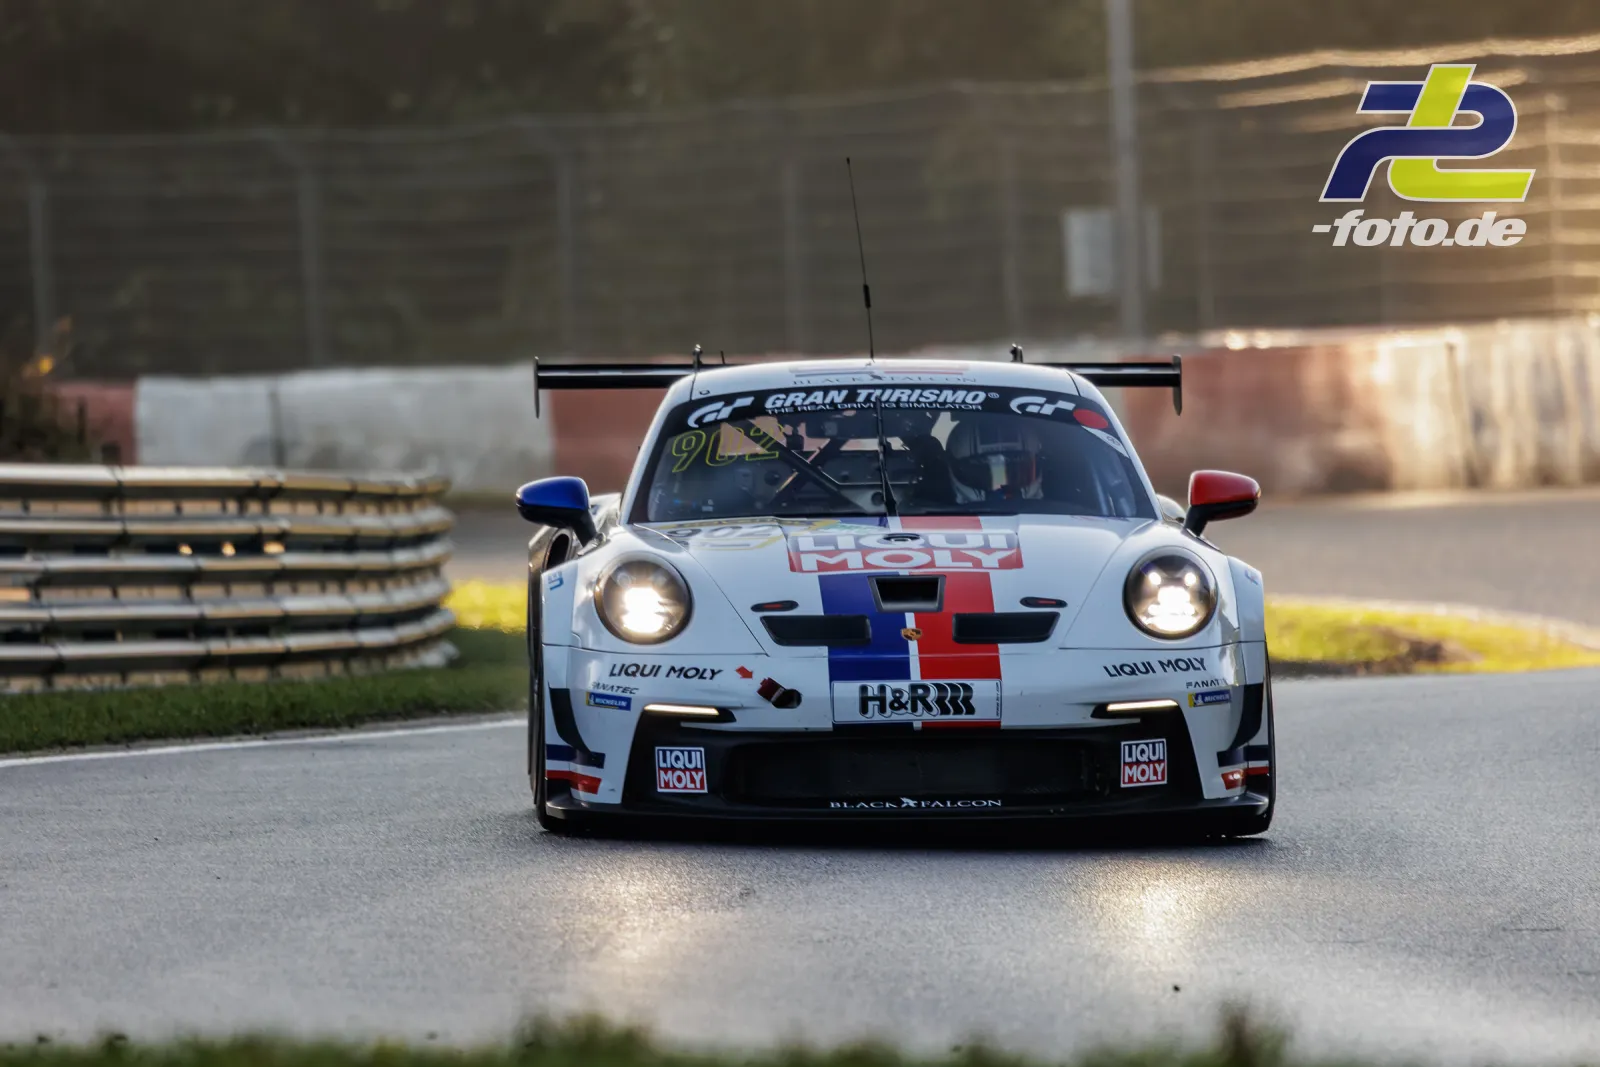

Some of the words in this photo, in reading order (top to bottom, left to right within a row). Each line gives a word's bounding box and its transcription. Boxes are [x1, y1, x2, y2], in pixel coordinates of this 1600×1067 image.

[764, 390, 849, 409] GRAN
[766, 407, 795, 415] THE
[799, 403, 836, 413] REAL
[900, 402, 982, 411] SIMULATOR
[672, 424, 784, 473] 902
[798, 533, 1009, 550] LIQUI
[800, 549, 1015, 571] MOLY
[608, 663, 662, 678] LIQUI
[665, 665, 723, 680] MOLY
[1103, 661, 1156, 677] LIQUI
[1158, 657, 1207, 673] MOLY
[659, 751, 701, 769] LIQUI
[1125, 743, 1164, 762] LIQUI
[660, 770, 703, 789] MOLY
[1125, 763, 1165, 783] MOLY
[829, 801, 898, 809] BLACK
[921, 799, 1001, 808] FALCON
